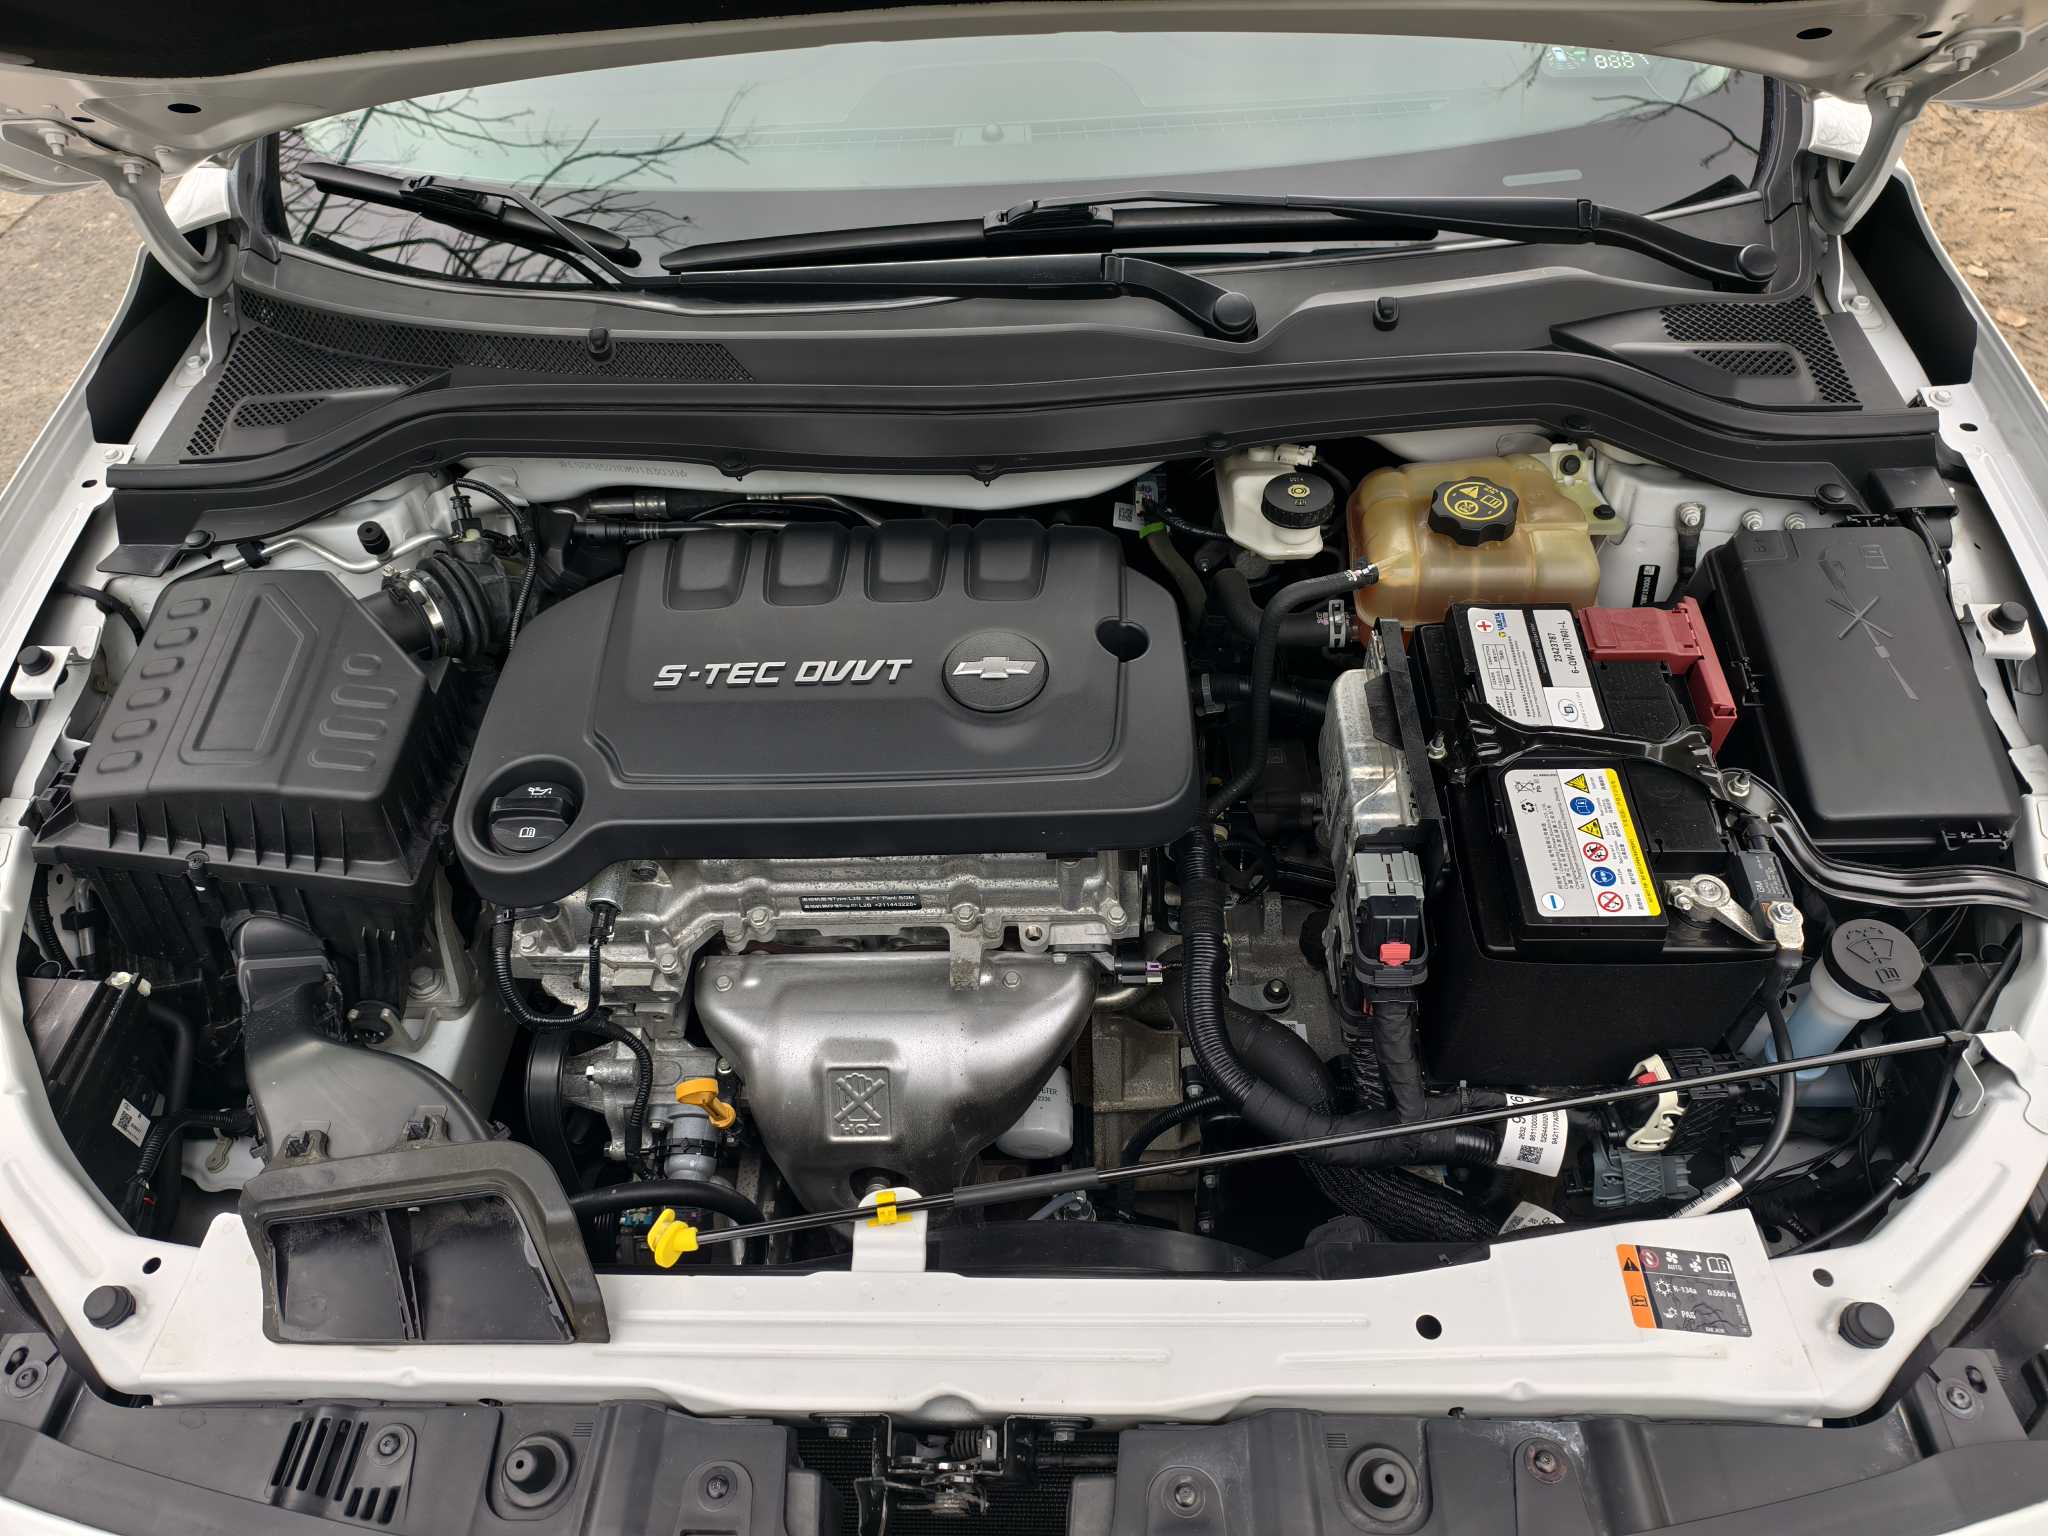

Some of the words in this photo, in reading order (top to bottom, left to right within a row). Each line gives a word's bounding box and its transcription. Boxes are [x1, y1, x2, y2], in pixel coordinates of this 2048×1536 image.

[1494, 612, 1504, 631] VARTA
[652, 661, 786, 688] S-TEC
[794, 659, 913, 686] DVVT
[840, 1123, 881, 1136] HOT
[1681, 1310, 1697, 1319] PAG
